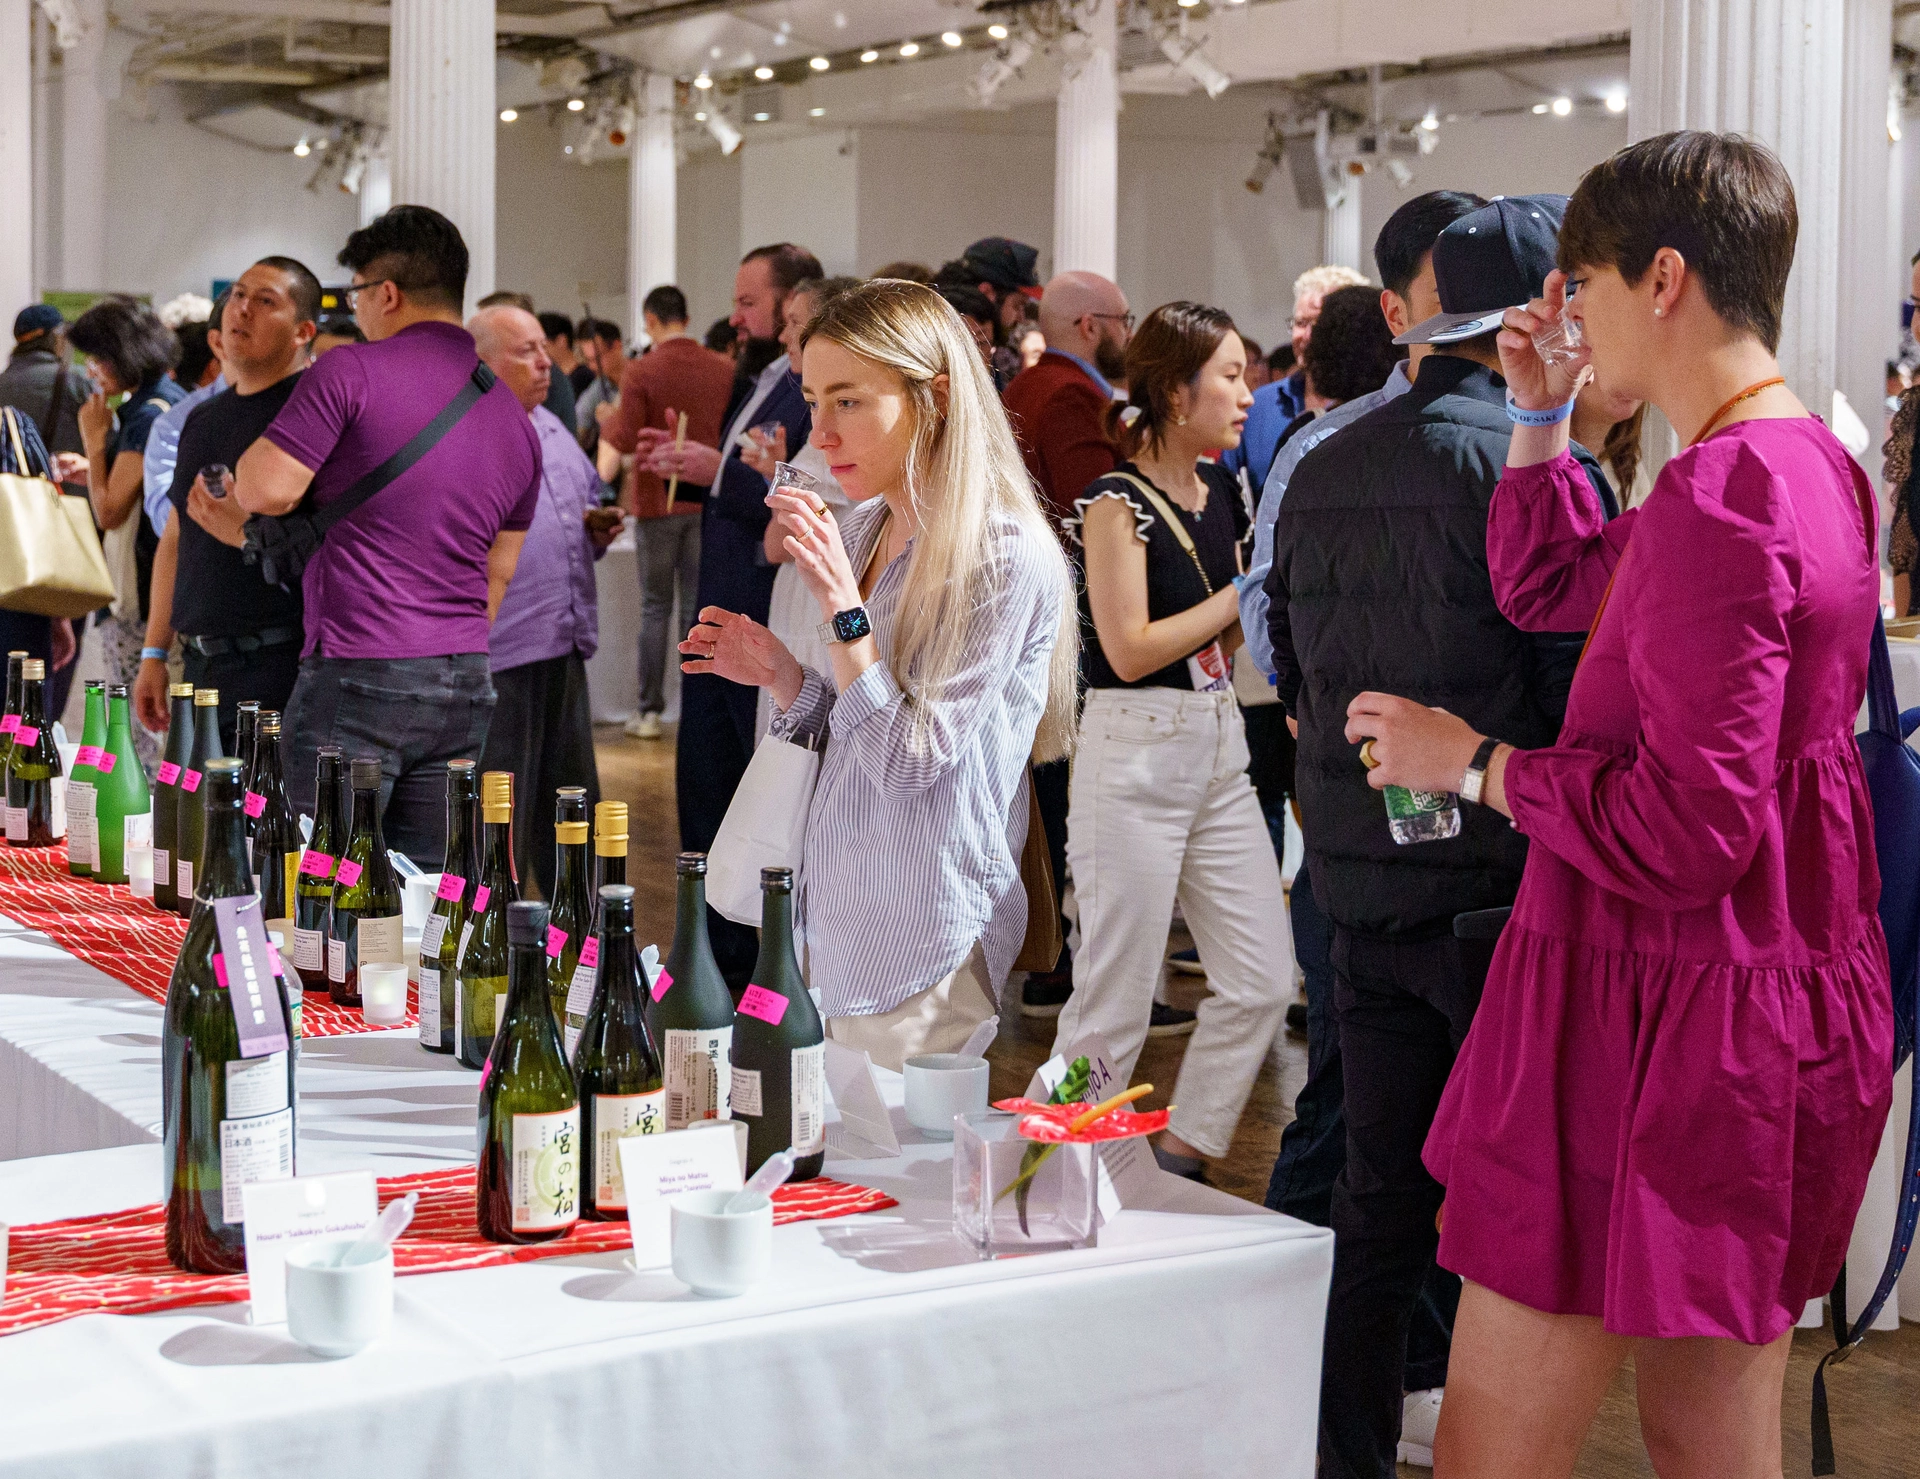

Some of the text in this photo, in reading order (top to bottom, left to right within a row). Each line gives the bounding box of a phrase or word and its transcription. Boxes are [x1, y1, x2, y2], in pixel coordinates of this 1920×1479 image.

[1533, 414, 1557, 423] SAKE
[552, 1121, 575, 1218] 宮の松
